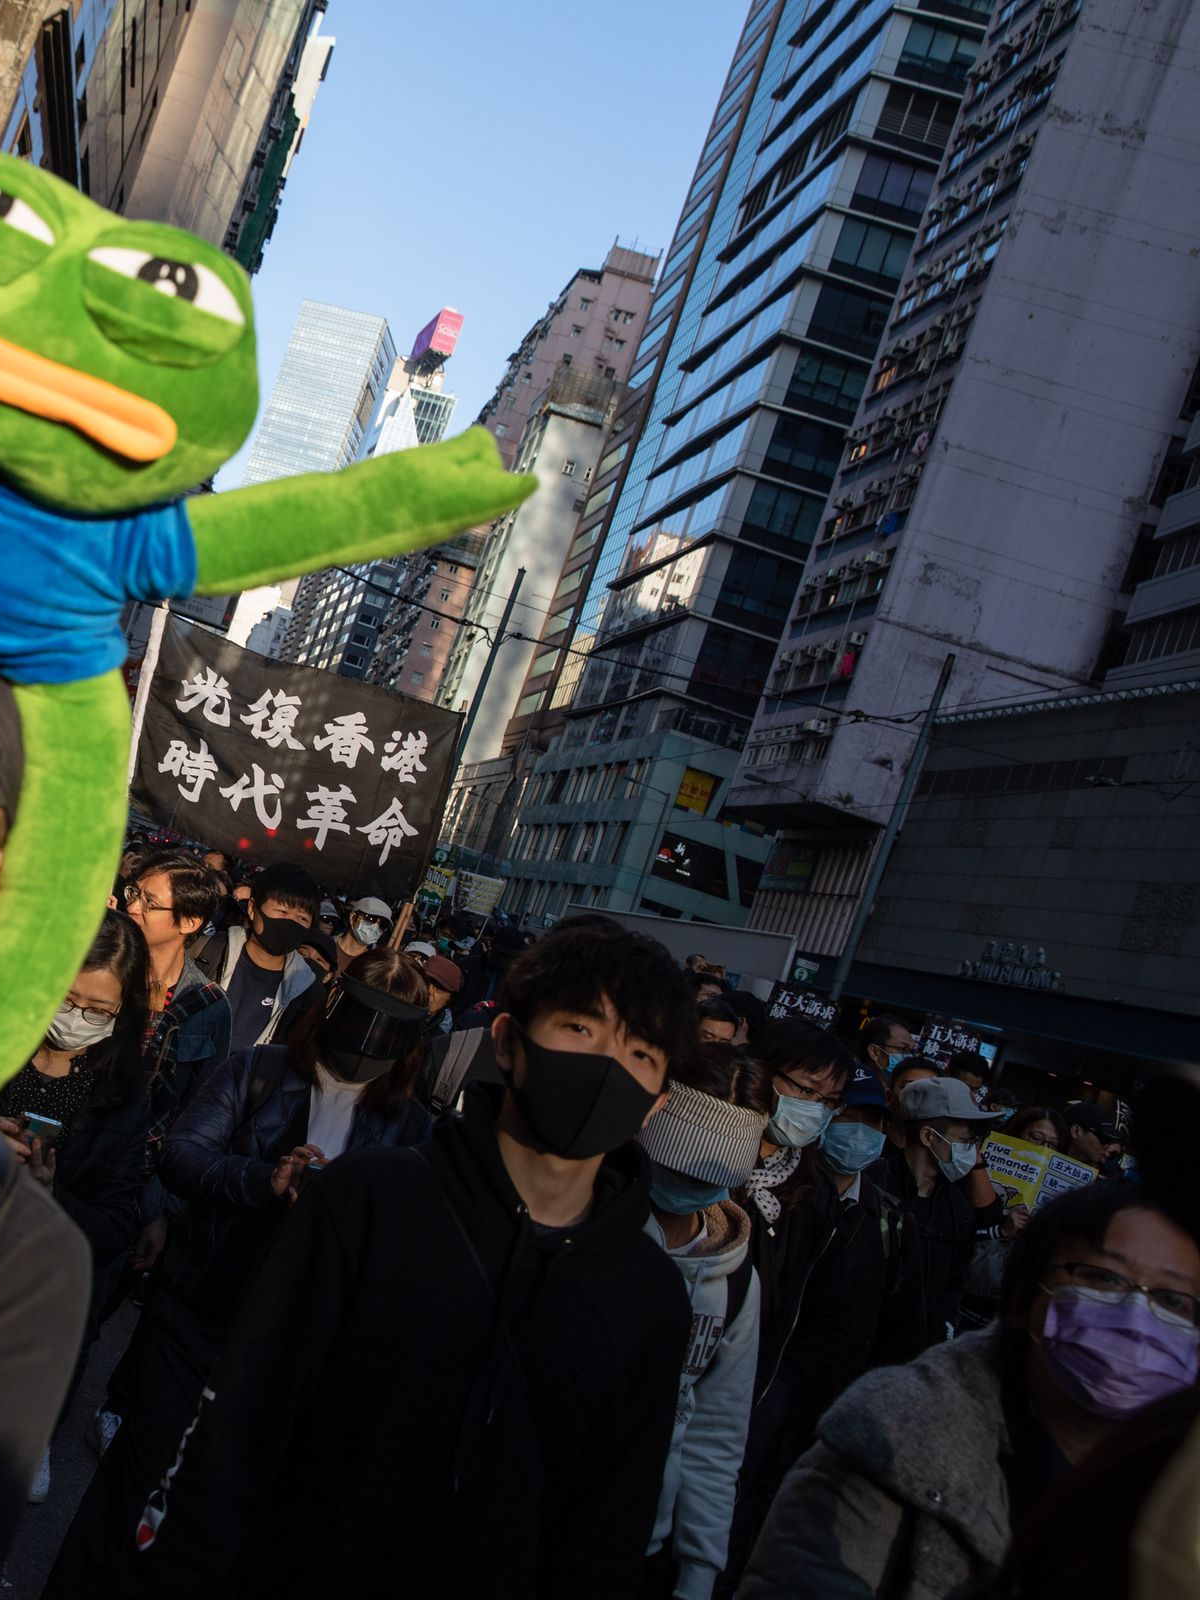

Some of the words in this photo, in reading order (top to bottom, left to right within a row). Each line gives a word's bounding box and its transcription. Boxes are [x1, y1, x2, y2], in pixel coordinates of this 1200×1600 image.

[175, 666, 428, 784] 光復香港
[157, 738, 420, 867] 時代革命
[778, 988, 836, 1021] 五大訴求
[927, 1023, 978, 1053] 五大訴求
[986, 1142, 1012, 1156] Five
